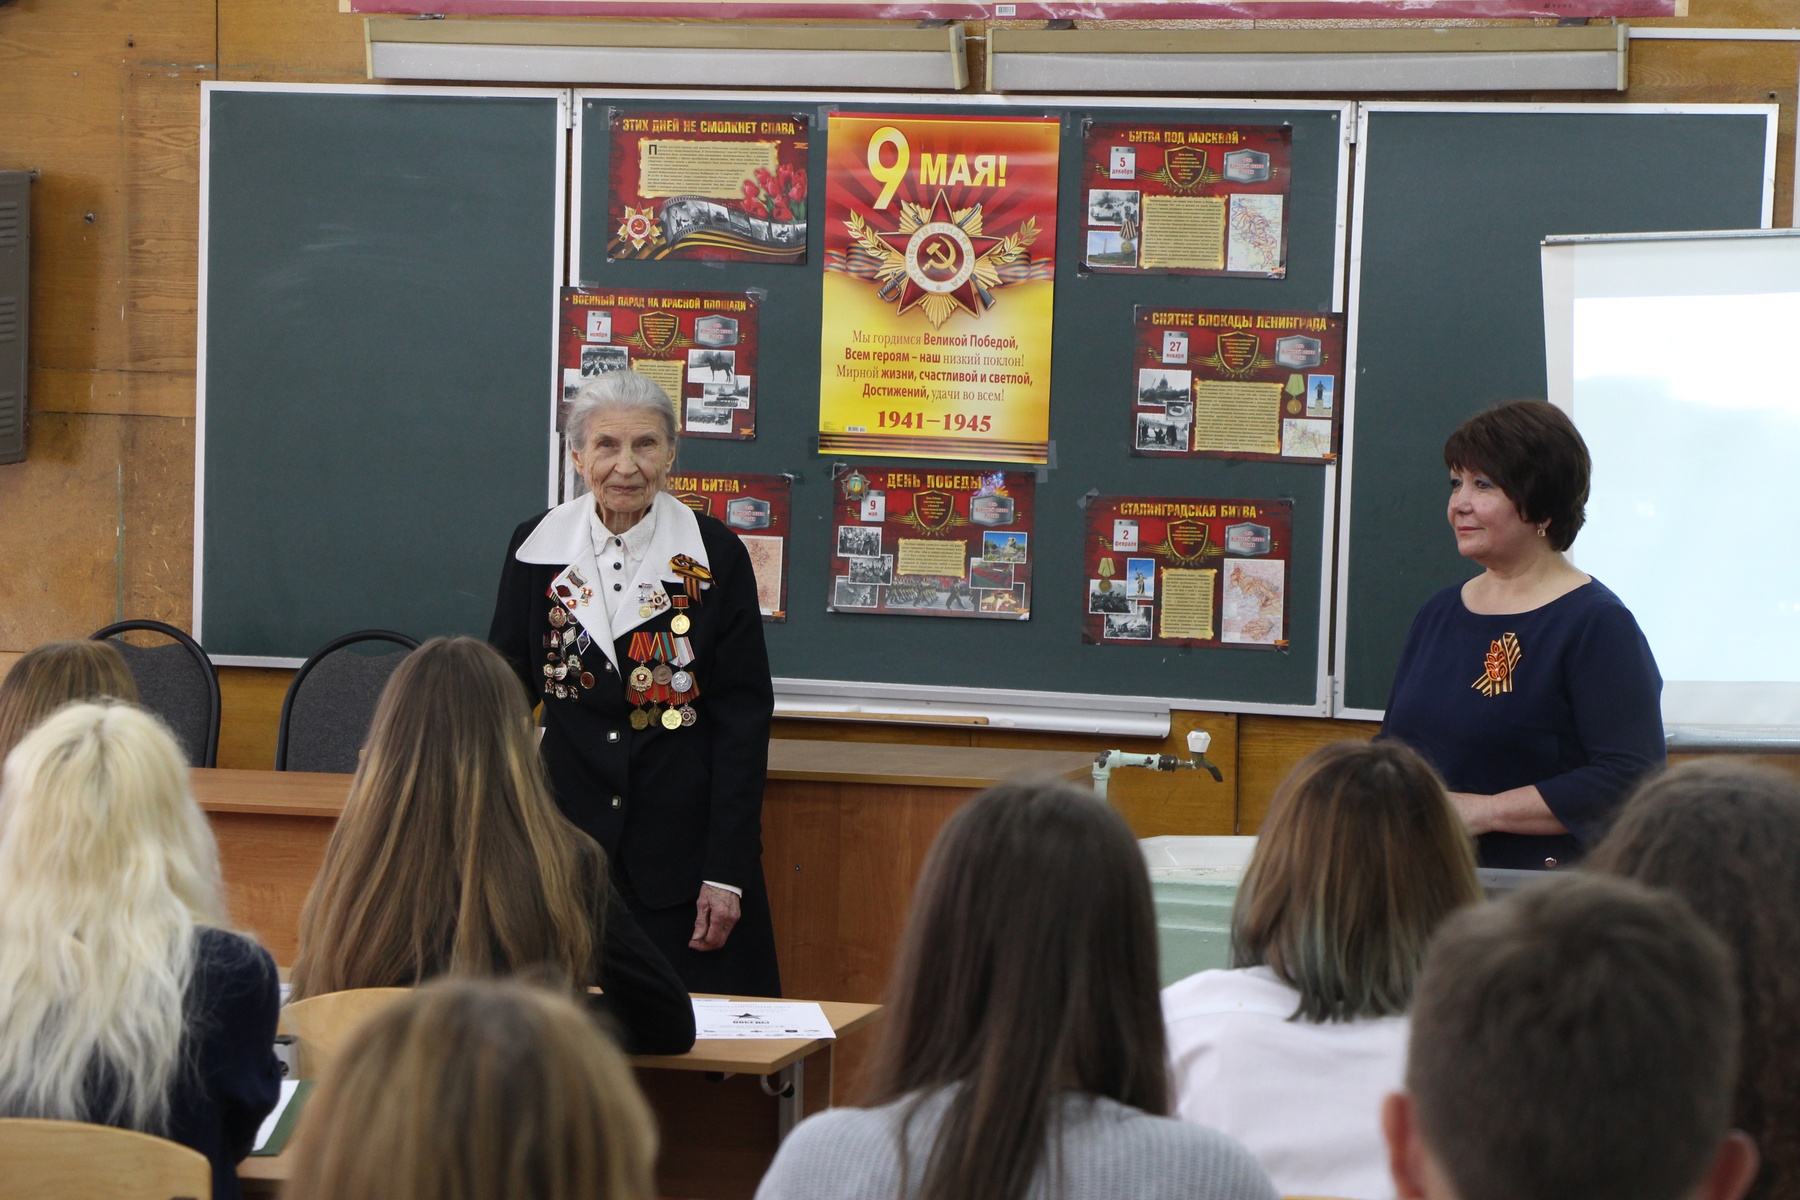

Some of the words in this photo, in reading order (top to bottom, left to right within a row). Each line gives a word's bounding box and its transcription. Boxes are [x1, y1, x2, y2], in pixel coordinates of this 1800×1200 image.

[622, 119, 649, 132] ЭТИХ
[652, 118, 680, 134] ДНЕЙ
[684, 120, 696, 132] НЕ
[700, 120, 757, 134] СМОЛКНЕТ
[761, 121, 795, 135] СЛАВА
[1128, 130, 1160, 144] БИТВА
[1164, 131, 1184, 145] ПОД
[1188, 131, 1239, 145] МОСКВОЙ
[868, 126, 910, 210] 9
[920, 153, 1007, 188] МАЯ!
[1120, 157, 1126, 168] 5
[1112, 168, 1134, 176] декабря
[572, 294, 615, 306] ВОЕННЫЙ
[618, 296, 645, 309] ПАРАД
[648, 298, 659, 308] НА
[662, 298, 700, 310] КРАСНОЙ
[704, 300, 746, 312] ПЛОЩАДИ
[596, 320, 602, 331] 7
[1152, 312, 1194, 326] СНЯТИЕ
[1198, 314, 1252, 330] БЛОКАДЫ
[1256, 316, 1328, 332] ЛЕНИНГРАДА
[852, 330, 870, 344] Мы
[872, 332, 922, 348] гордимся
[923, 332, 968, 348] Великой
[970, 334, 1019, 350] Победой,
[1169, 341, 1182, 352] 27
[845, 348, 870, 361] Всем
[872, 352, 910, 364] героям
[920, 354, 940, 364] наш
[943, 353, 980, 366] низкий
[983, 354, 1025, 367] поклон!
[1166, 352, 1185, 360] января
[836, 365, 880, 382] Мирной
[880, 368, 917, 382] жизни,
[919, 370, 978, 383] счастливой
[980, 373, 987, 384] и
[989, 371, 1034, 386] светлой,
[862, 383, 930, 400] Достижений,
[931, 388, 960, 402] удачи
[962, 390, 975, 400] во
[977, 389, 1005, 402] всем!
[668, 477, 697, 492] СКАЯ
[702, 478, 740, 493] БИТВА
[887, 473, 921, 490] ДЕНЬ
[926, 474, 982, 491] ПОБЕДЫ
[870, 500, 877, 510] 9
[1120, 502, 1216, 518] СТАЛИНГРАДСКАЯ
[1220, 504, 1257, 518] БИТВА
[1122, 530, 1130, 540] 2
